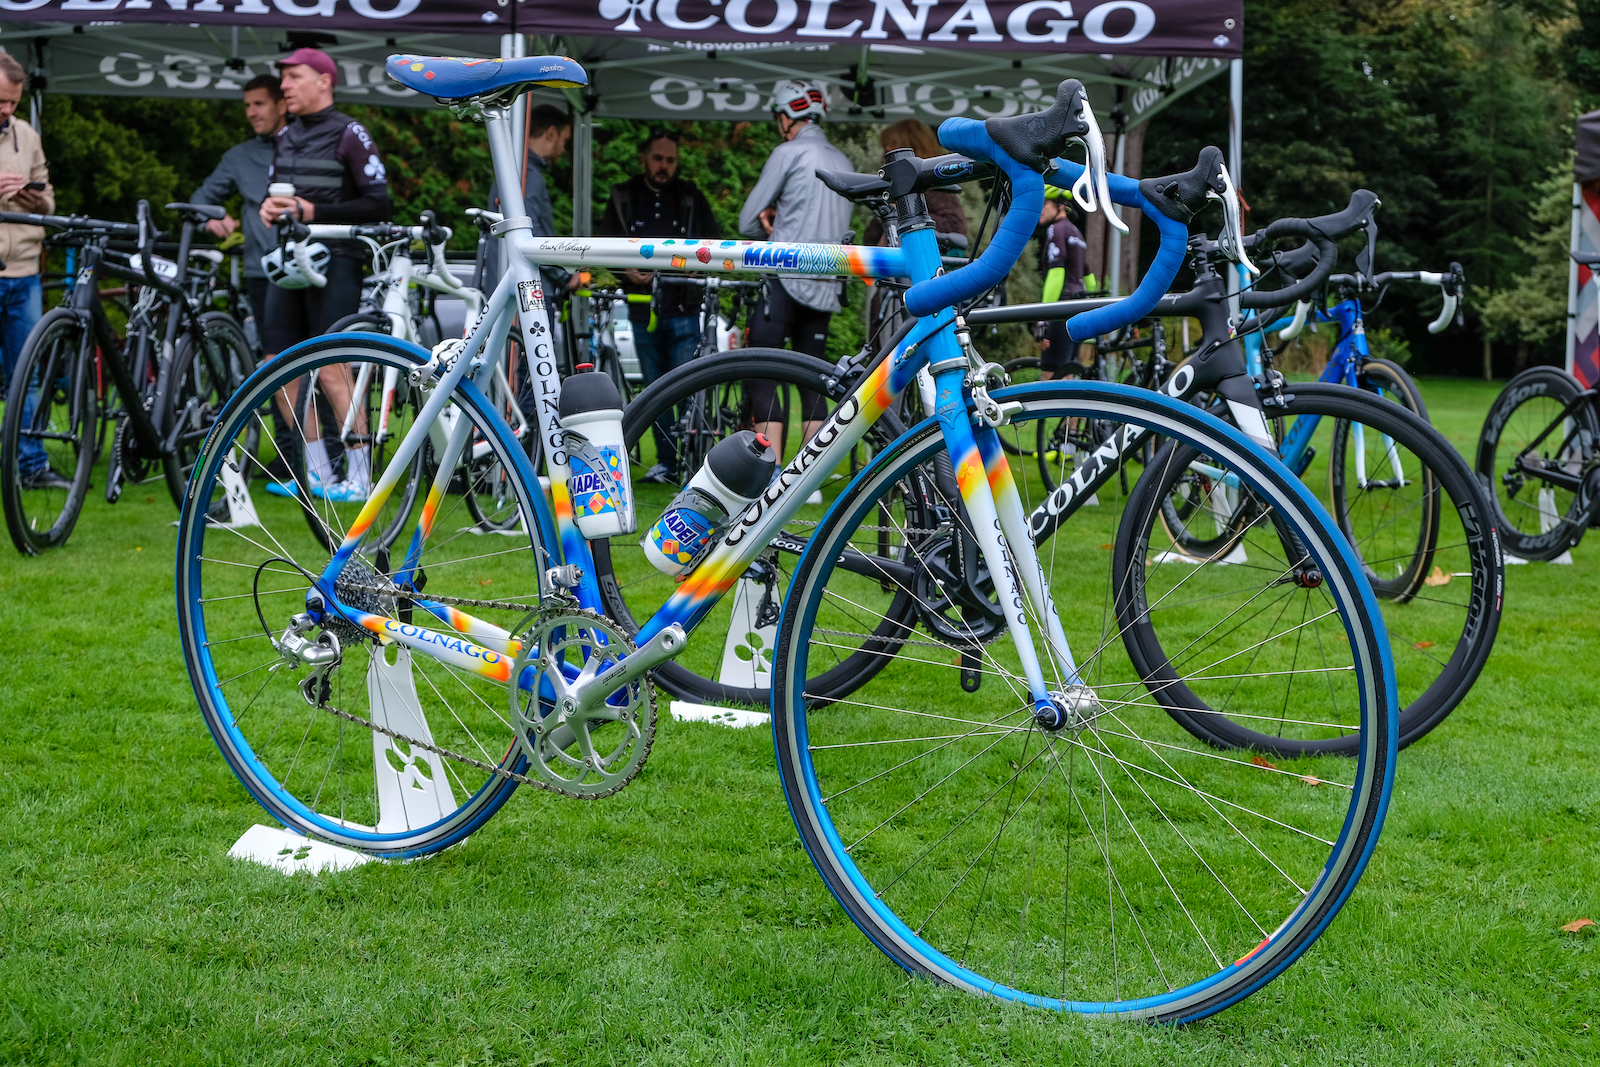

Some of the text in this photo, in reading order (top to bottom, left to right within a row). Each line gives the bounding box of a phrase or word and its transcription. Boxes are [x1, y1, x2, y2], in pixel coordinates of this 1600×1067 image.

[655, 0, 1157, 44] COLNAGO
[743, 246, 800, 270] MAPEI
[534, 343, 568, 466] COLNAGO
[725, 395, 859, 546] COLNAGO
[1027, 364, 1196, 537] COLNAO
[384, 620, 501, 664] COLNAGO
